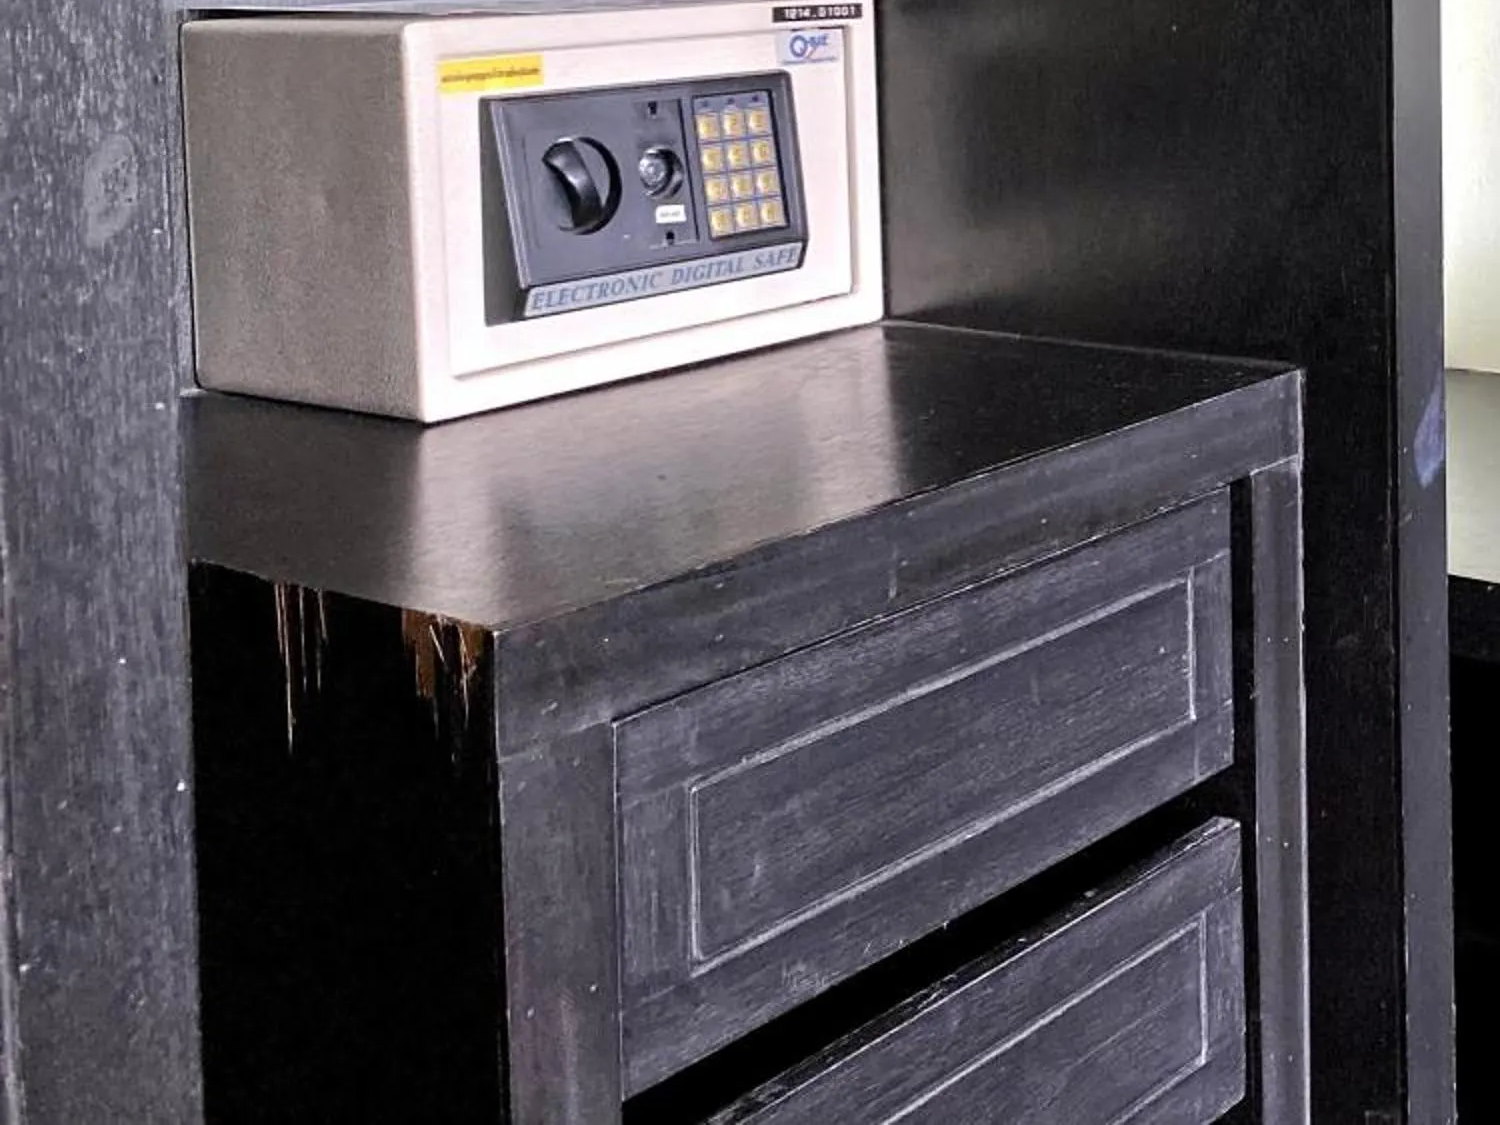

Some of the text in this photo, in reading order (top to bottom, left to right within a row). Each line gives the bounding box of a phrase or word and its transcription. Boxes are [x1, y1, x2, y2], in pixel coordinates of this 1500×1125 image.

[531, 246, 799, 311] ELECTRONIC DIGITAL SAFE
